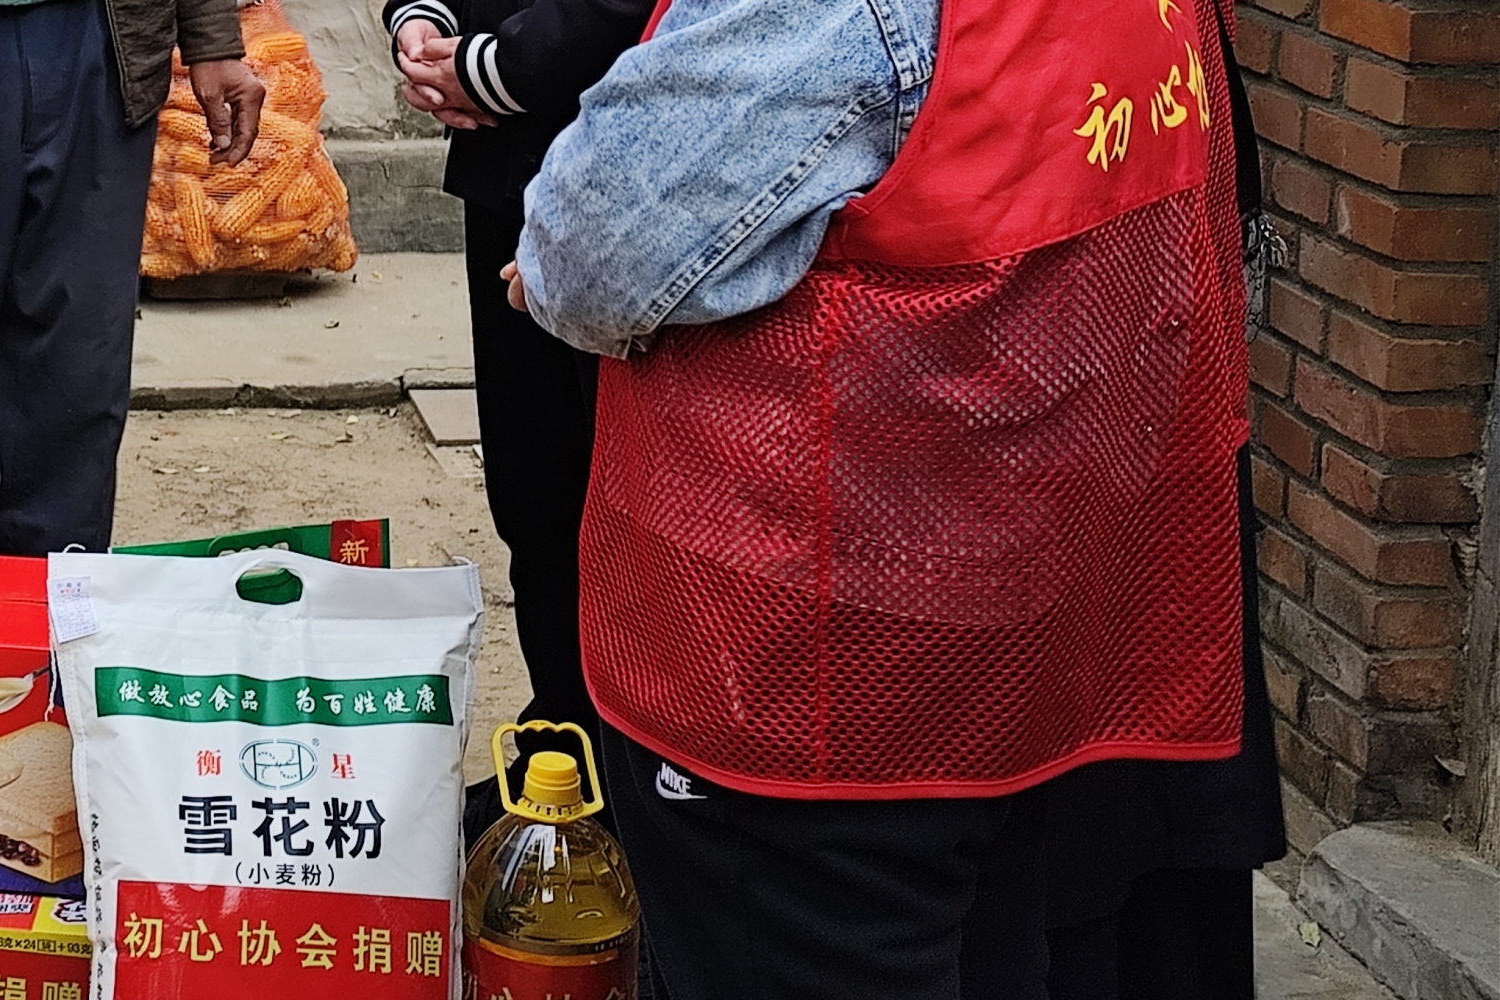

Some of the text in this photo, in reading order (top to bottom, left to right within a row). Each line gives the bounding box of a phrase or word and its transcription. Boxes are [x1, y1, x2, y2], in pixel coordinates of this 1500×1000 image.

[339, 538, 369, 565] 新
[119, 679, 437, 715] 做放心食品 为百姓健康
[196, 750, 356, 779] 衡 星
[661, 762, 692, 795] NIKE
[178, 795, 386, 859] 雪花粉
[235, 861, 336, 887] (小麦粉)
[123, 912, 443, 978] 初心协会捐赠
